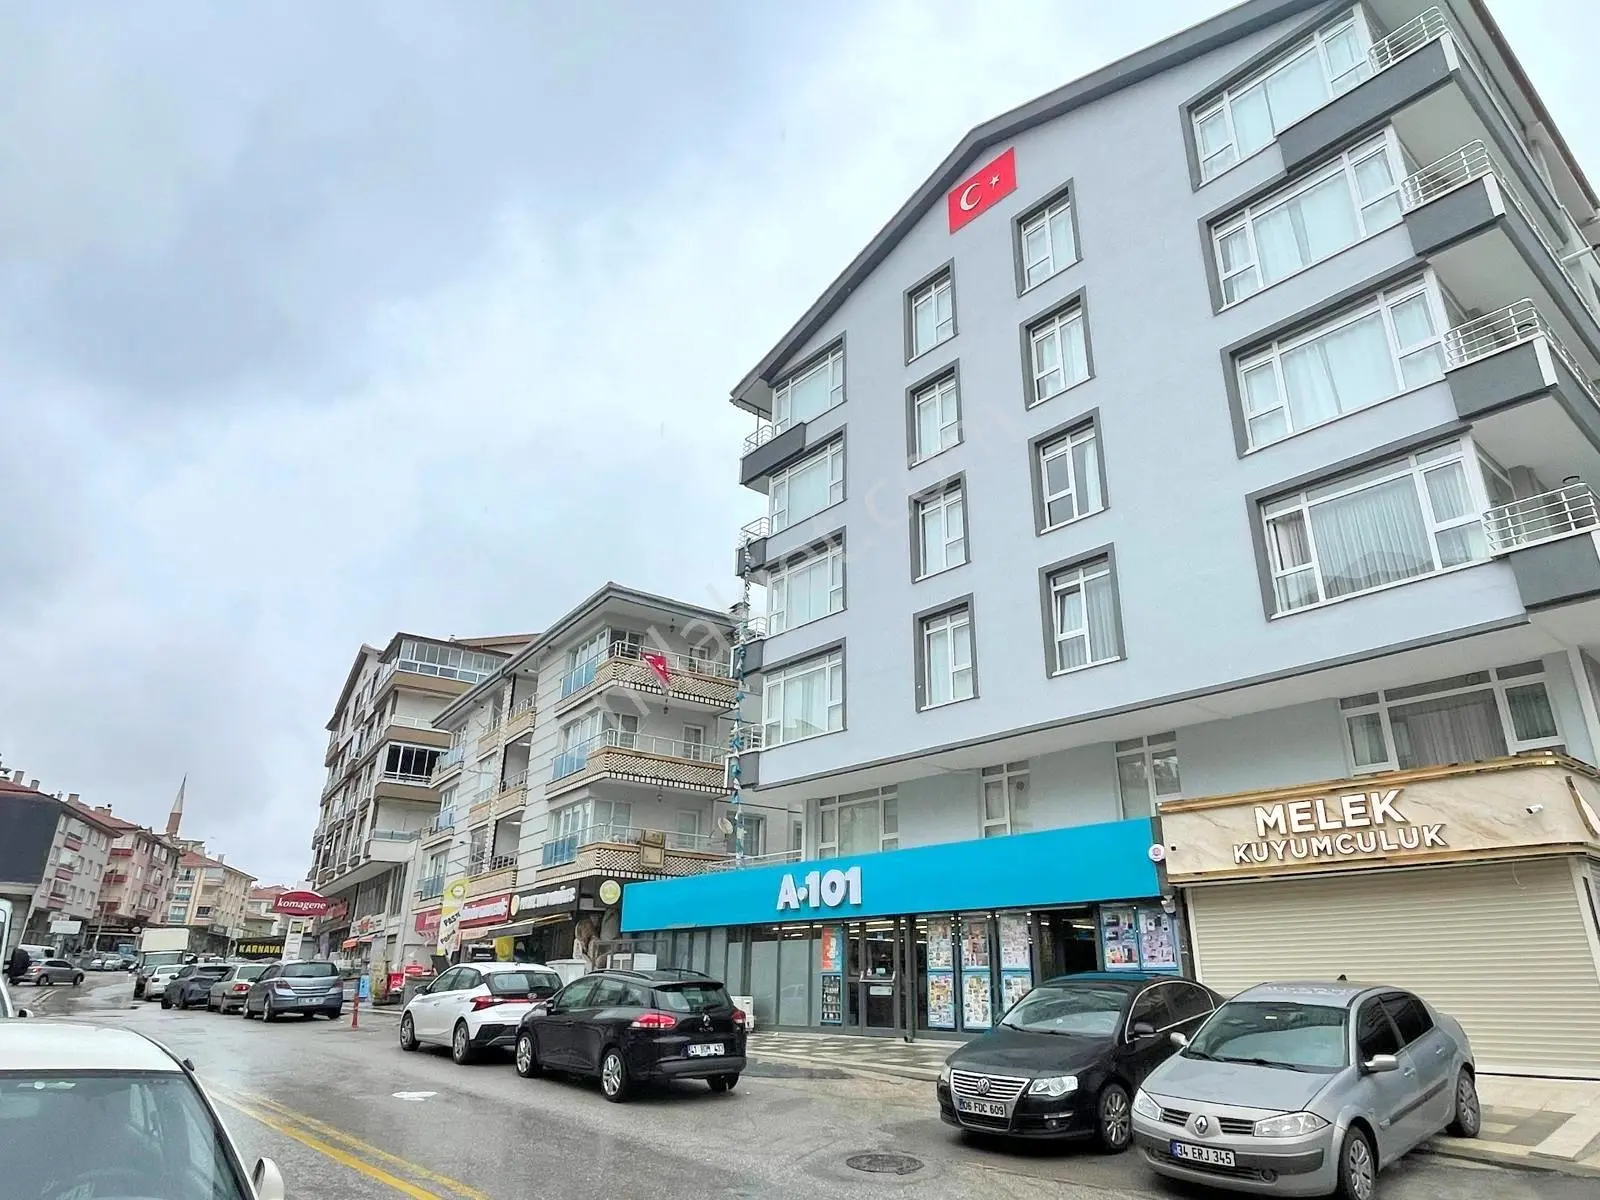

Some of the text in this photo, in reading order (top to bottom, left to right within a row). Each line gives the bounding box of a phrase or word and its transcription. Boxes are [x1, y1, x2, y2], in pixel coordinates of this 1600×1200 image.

[1254, 788, 1408, 837] MELEK
[1232, 823, 1448, 864] KUYUMCULUK
[277, 897, 326, 910] komagene
[963, 1100, 1003, 1115] 06 FDC 609
[1177, 1144, 1232, 1165] 34 ERJ 345
